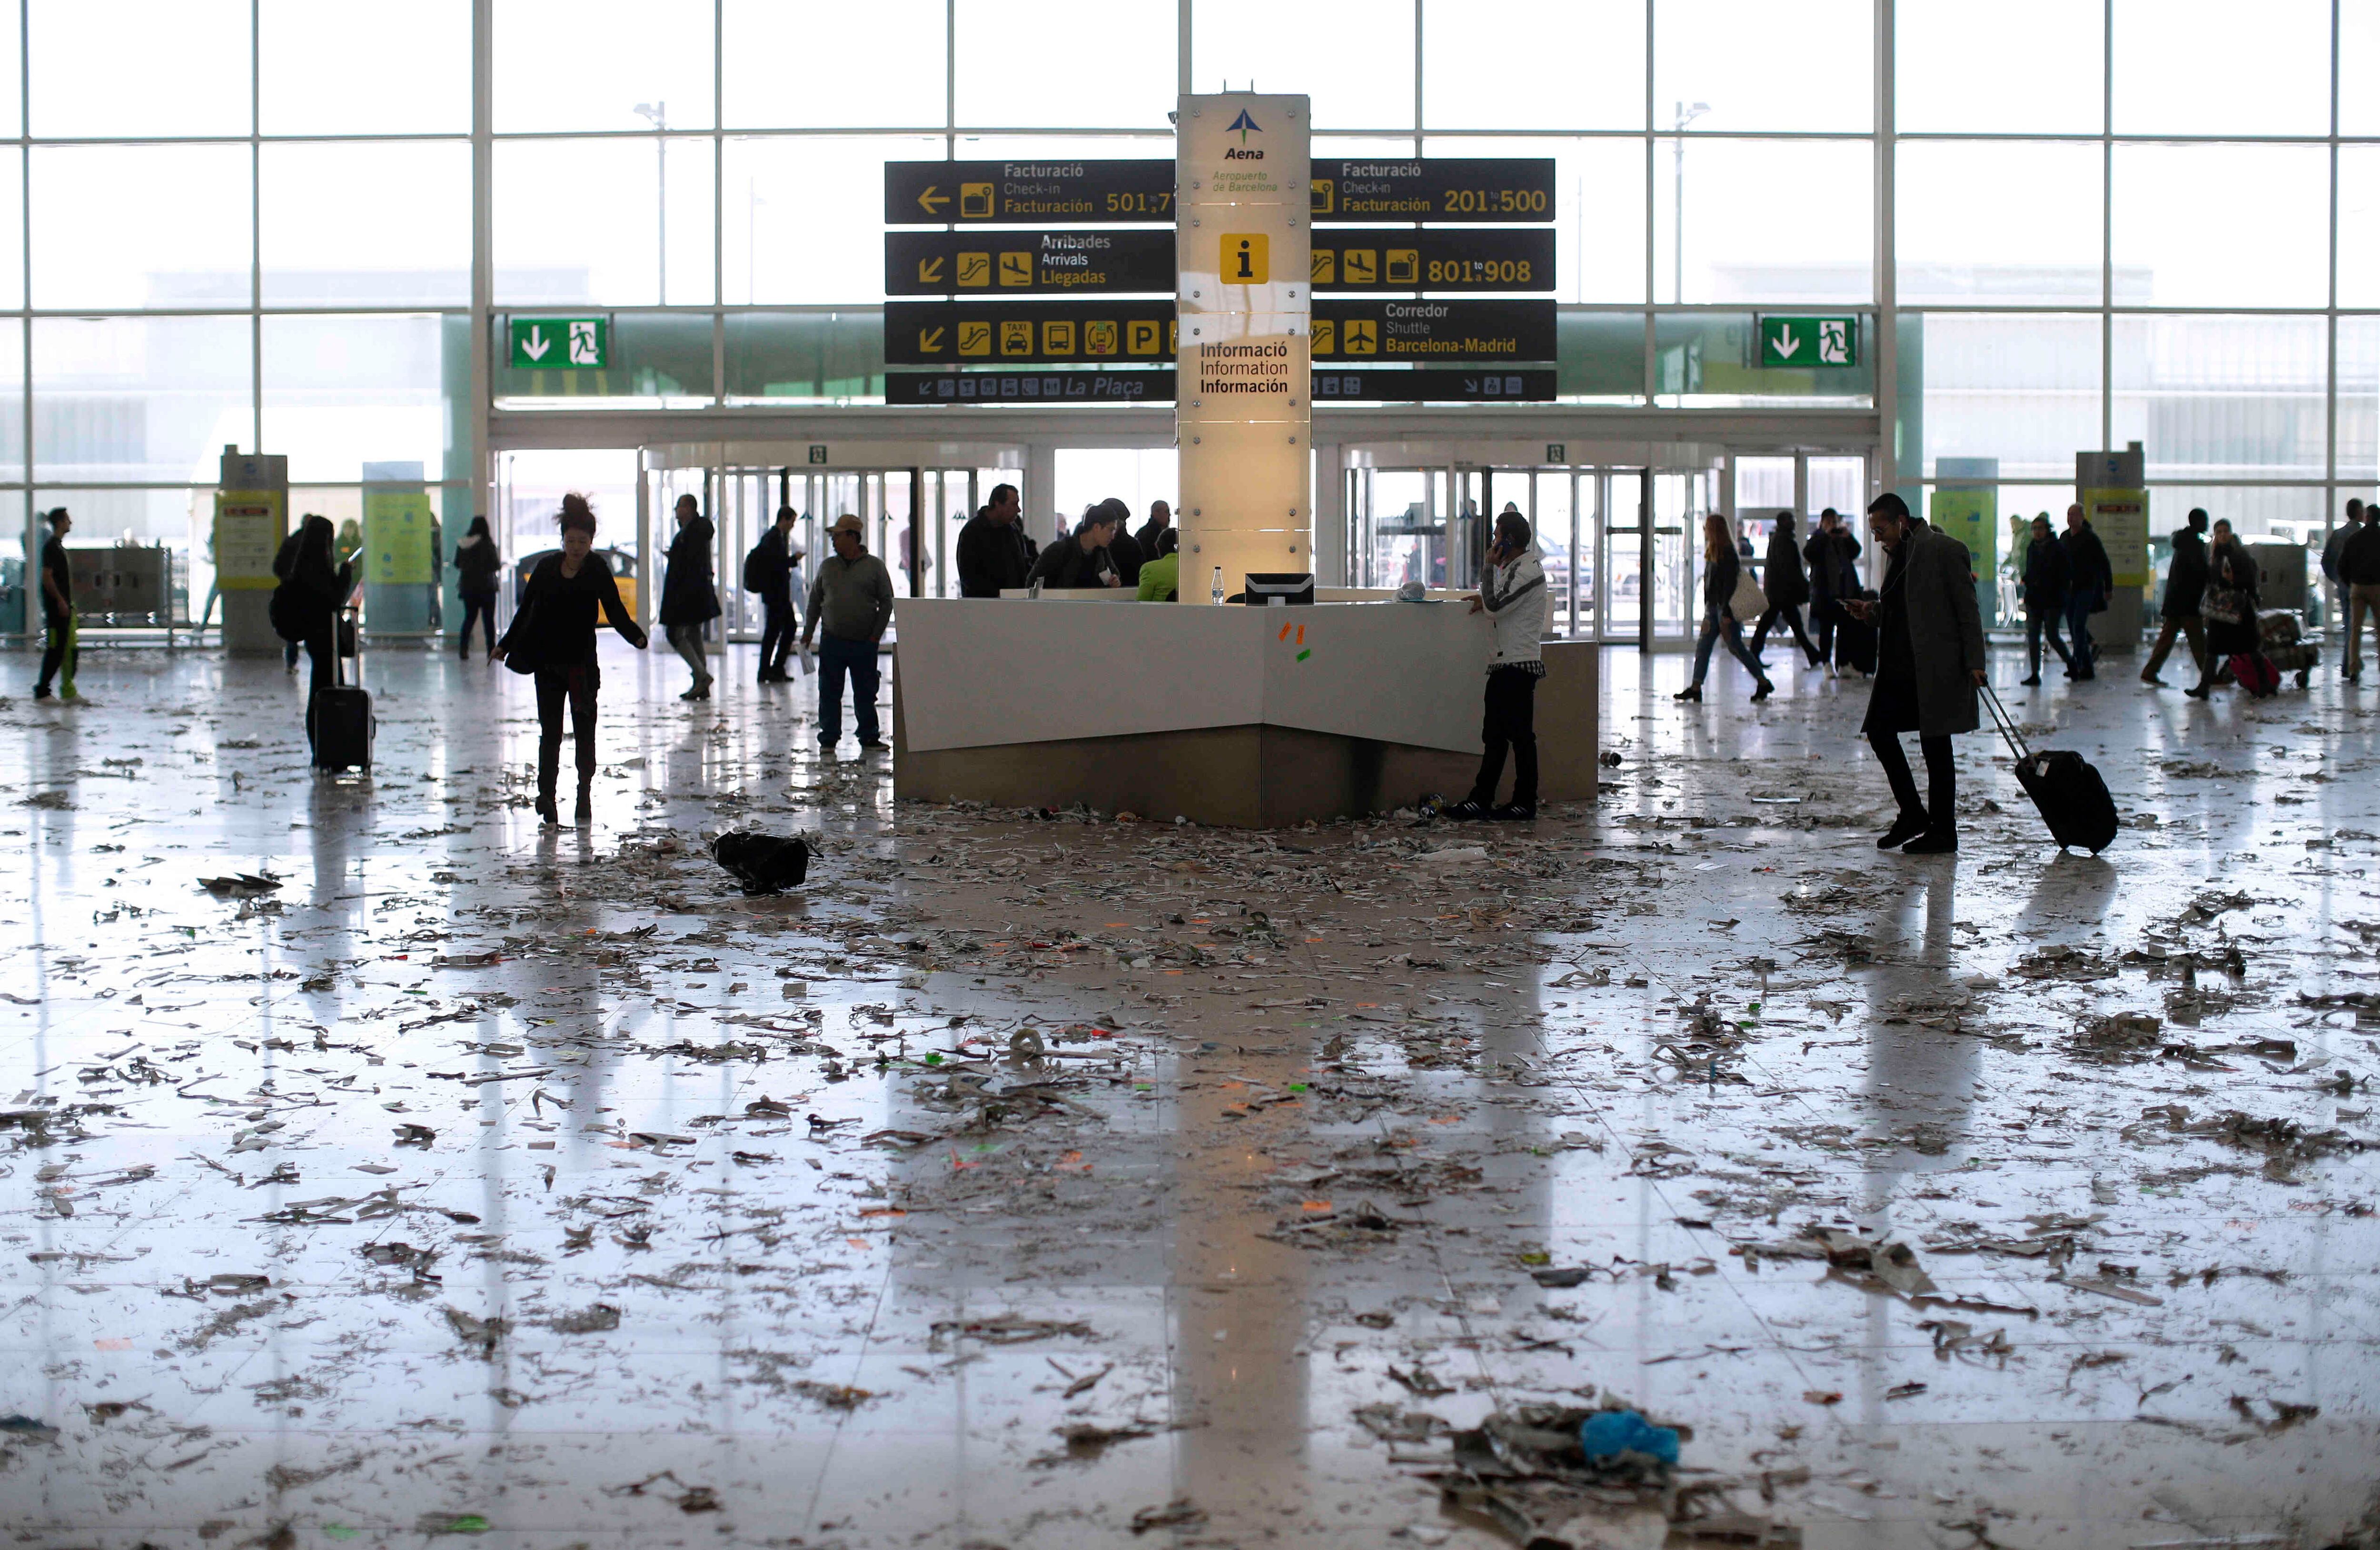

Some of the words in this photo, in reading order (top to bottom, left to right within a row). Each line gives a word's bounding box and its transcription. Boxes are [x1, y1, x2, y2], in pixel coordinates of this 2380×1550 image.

[1225, 148, 1264, 159] Aena
[1004, 163, 1083, 177] Facturació
[1213, 171, 1268, 181] Aeropuerto
[1343, 162, 1421, 176] Facturació
[1004, 183, 1060, 194] Check-in
[1213, 183, 1225, 191] de
[1229, 182, 1278, 192] Barcelona
[1343, 181, 1390, 194] Check-in
[1005, 199, 1093, 212] Facturación
[1107, 193, 1146, 211] 501
[1343, 198, 1430, 211] Facturación
[1445, 190, 1488, 211] 201
[1501, 190, 1546, 211] 500
[1041, 235, 1110, 248] Arribades
[1042, 253, 1088, 265] Arrivals
[1238, 240, 1253, 277] i
[1042, 269, 1106, 287] Llegadas
[1428, 260, 1473, 282] 801
[1485, 260, 1531, 282] 908
[1386, 303, 1448, 317] Corredor
[1387, 321, 1430, 334] Shuttle
[1136, 327, 1152, 349] P
[1387, 338, 1516, 352] Barcelona-Madrid
[1200, 340, 1288, 358] Informació
[1201, 360, 1287, 375] Information
[1065, 377, 1086, 396] La
[1093, 377, 1144, 400] Plaça
[1201, 378, 1287, 393] Información
